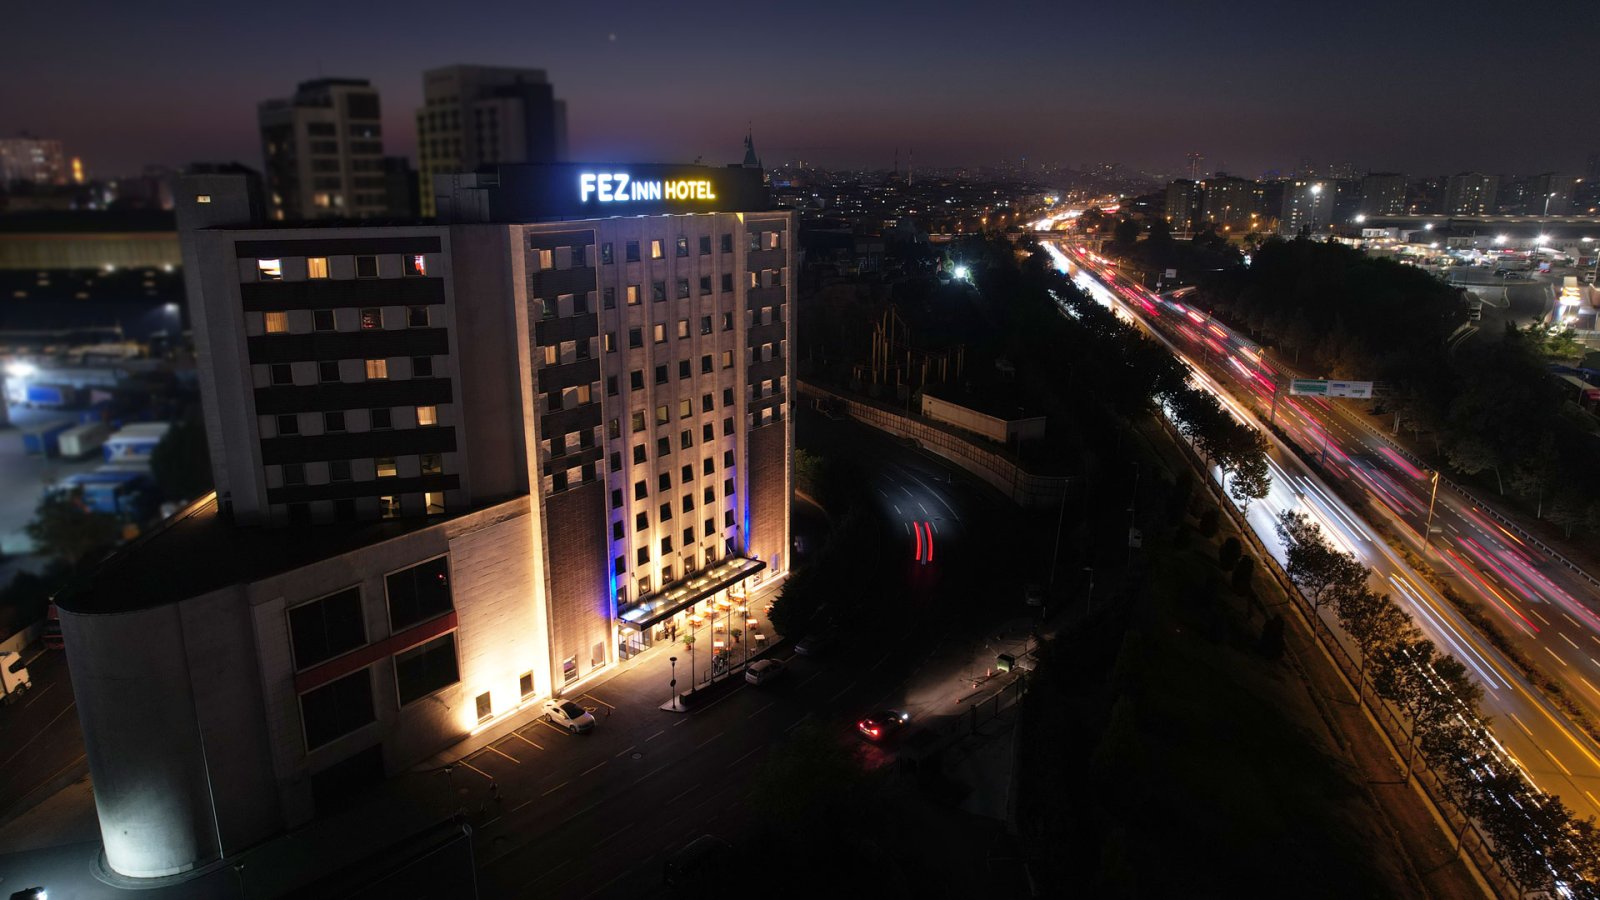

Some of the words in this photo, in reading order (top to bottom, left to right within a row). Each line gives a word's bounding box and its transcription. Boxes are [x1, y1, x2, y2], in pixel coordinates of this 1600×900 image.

[580, 173, 630, 202] FEZ
[631, 181, 661, 200] INN
[665, 181, 716, 199] HOTEL
